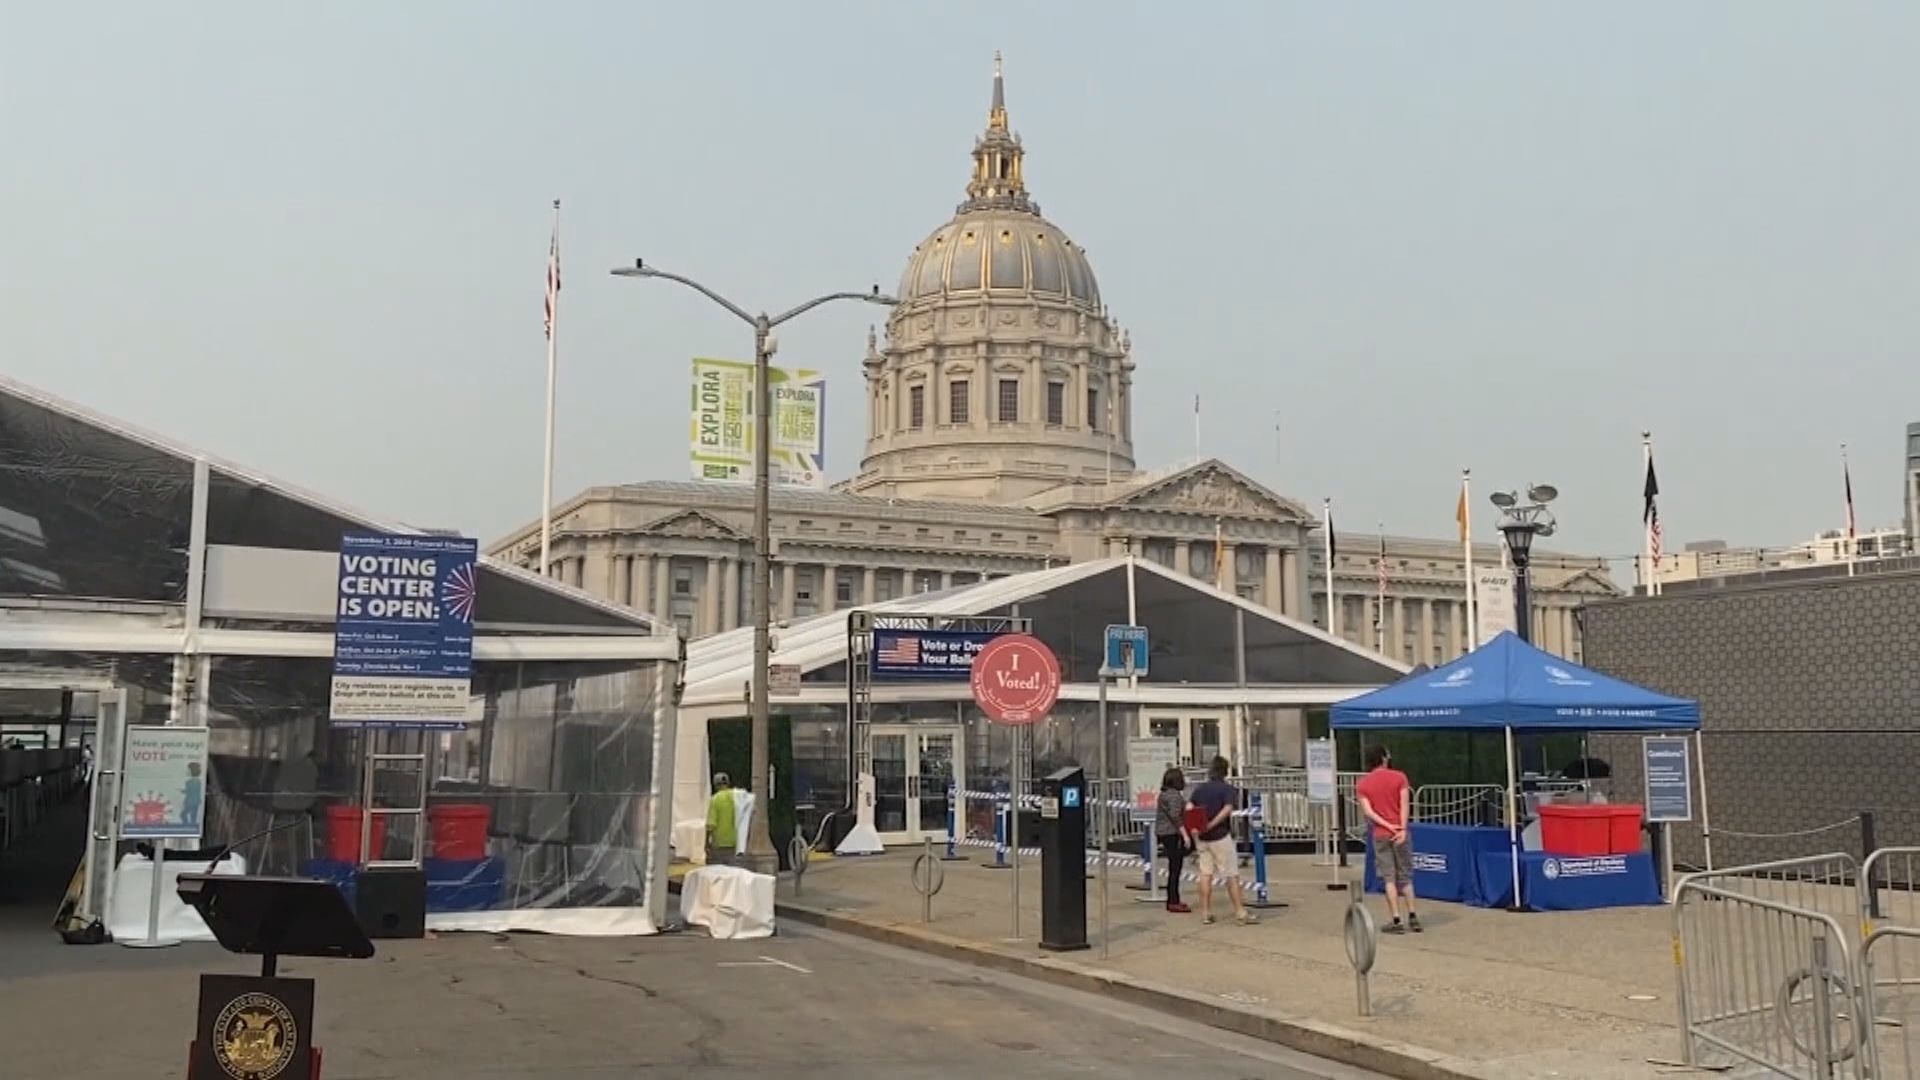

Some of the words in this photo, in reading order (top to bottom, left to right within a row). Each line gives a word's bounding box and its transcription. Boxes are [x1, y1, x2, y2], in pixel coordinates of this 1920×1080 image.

[776, 388, 816, 402] EXPLORA
[701, 371, 720, 446] EXPLORA
[343, 554, 437, 577] VOTING
[340, 576, 435, 598] CENTER
[339, 598, 362, 616] IS
[367, 599, 440, 619] OPEN:
[1109, 628, 1124, 639] PAY
[1125, 629, 1145, 640] HERE
[921, 639, 948, 651] Vote
[949, 642, 962, 651] or
[963, 640, 987, 651] Dro
[921, 652, 948, 664] Your
[1011, 654, 1020, 671] I
[335, 682, 350, 690] City
[352, 682, 387, 690] residents
[996, 671, 1041, 689] Voted!
[334, 691, 354, 699] drop
[133, 739, 158, 748] Have
[160, 741, 183, 750] your
[132, 750, 167, 761] VOTE
